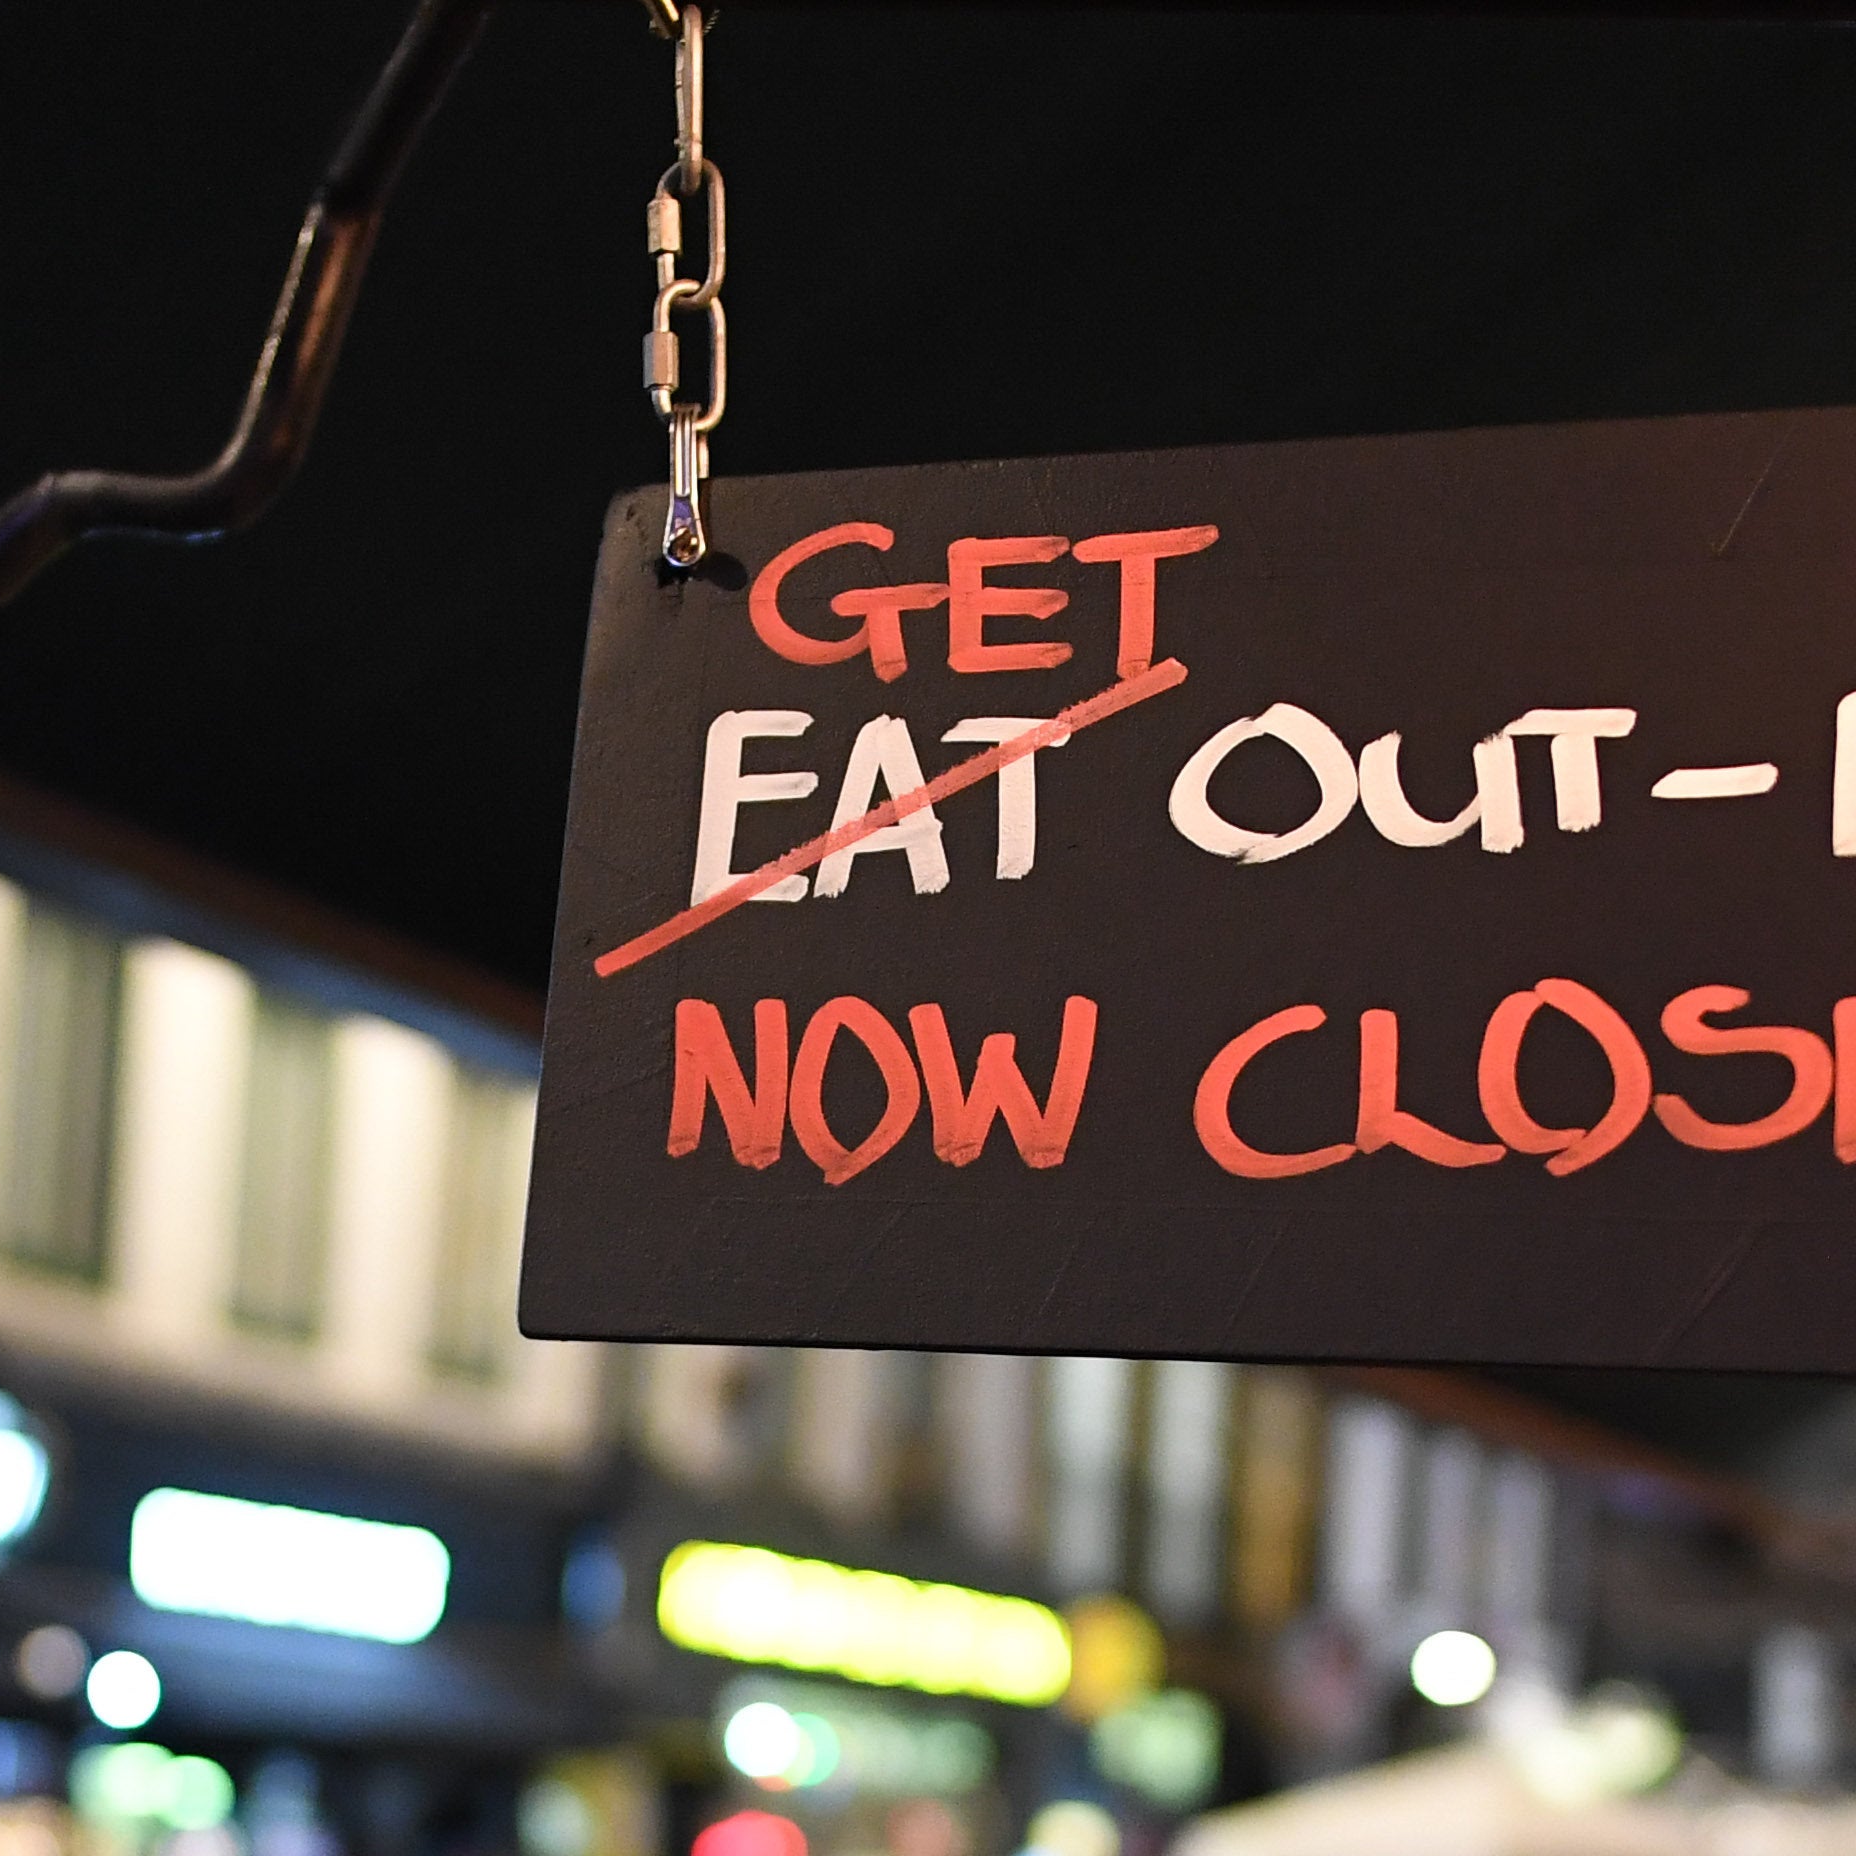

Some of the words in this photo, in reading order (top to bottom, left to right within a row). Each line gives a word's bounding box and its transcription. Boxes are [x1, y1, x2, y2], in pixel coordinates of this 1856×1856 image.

[748, 520, 1220, 683] GET
[688, 707, 1072, 908] EAT
[667, 995, 1099, 1187] NOW
